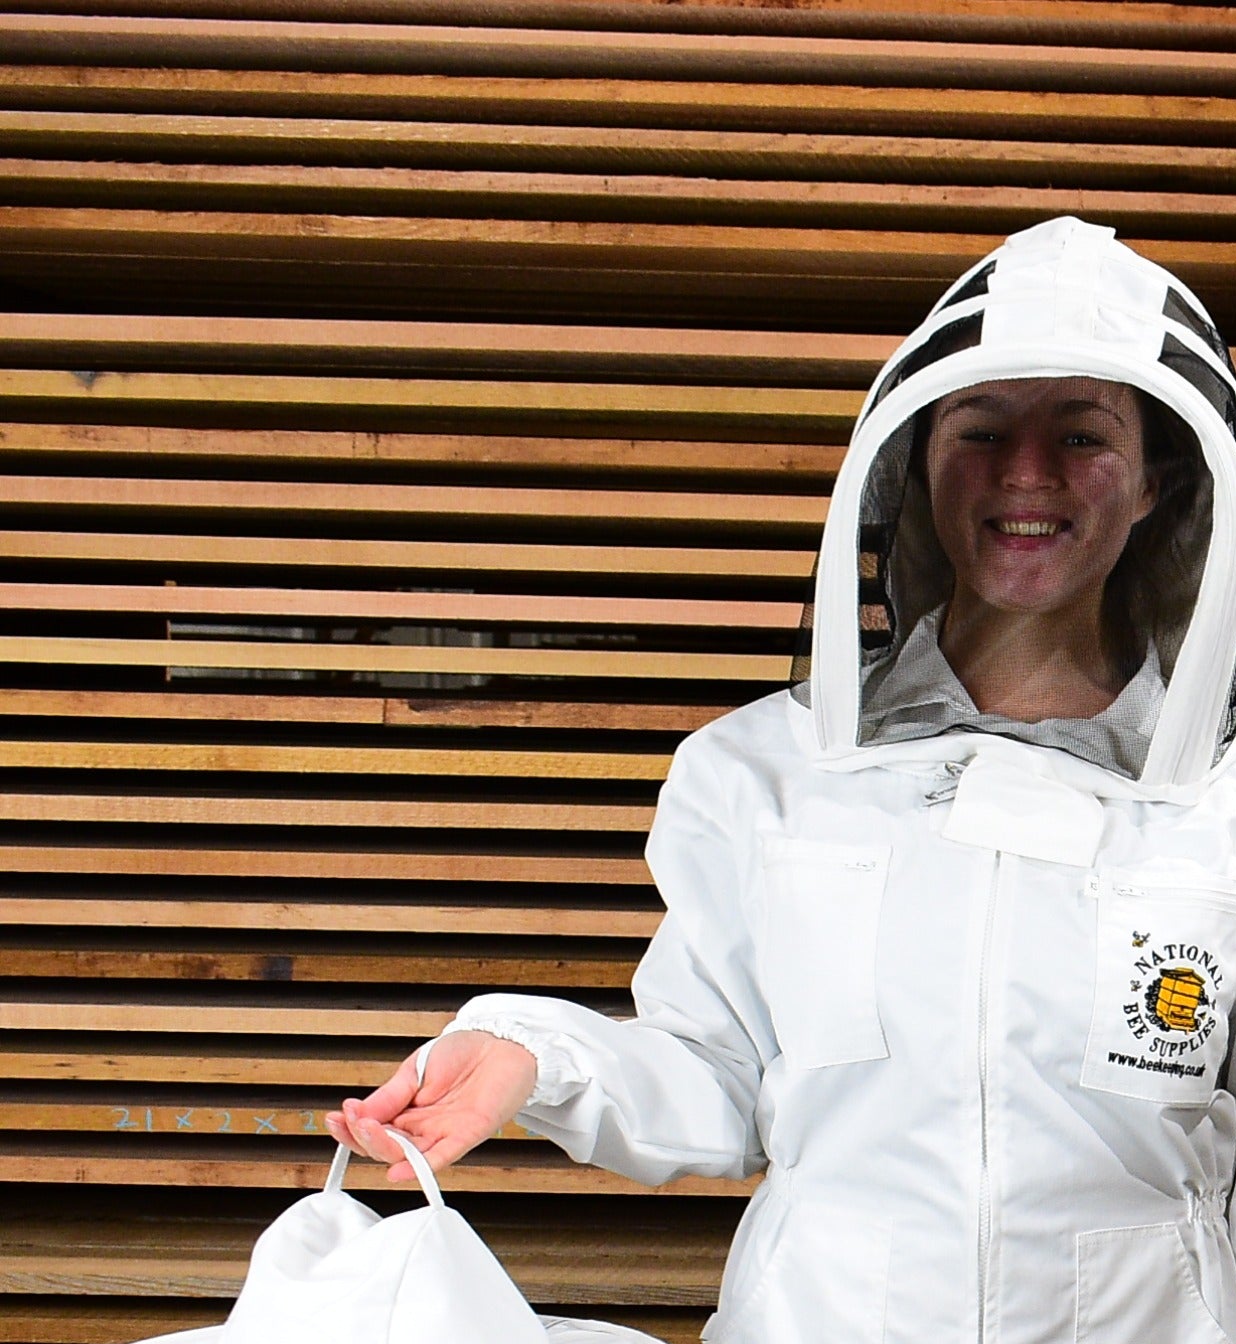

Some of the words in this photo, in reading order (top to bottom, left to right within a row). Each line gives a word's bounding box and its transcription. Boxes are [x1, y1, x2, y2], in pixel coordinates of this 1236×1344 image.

[1134, 944, 1224, 990] NATIONAL
[1123, 1002, 1150, 1039] BEE
[1150, 1017, 1217, 1057] SUPPLIES
[112, 1106, 152, 1132] 21
[217, 1110, 233, 1133] 2
